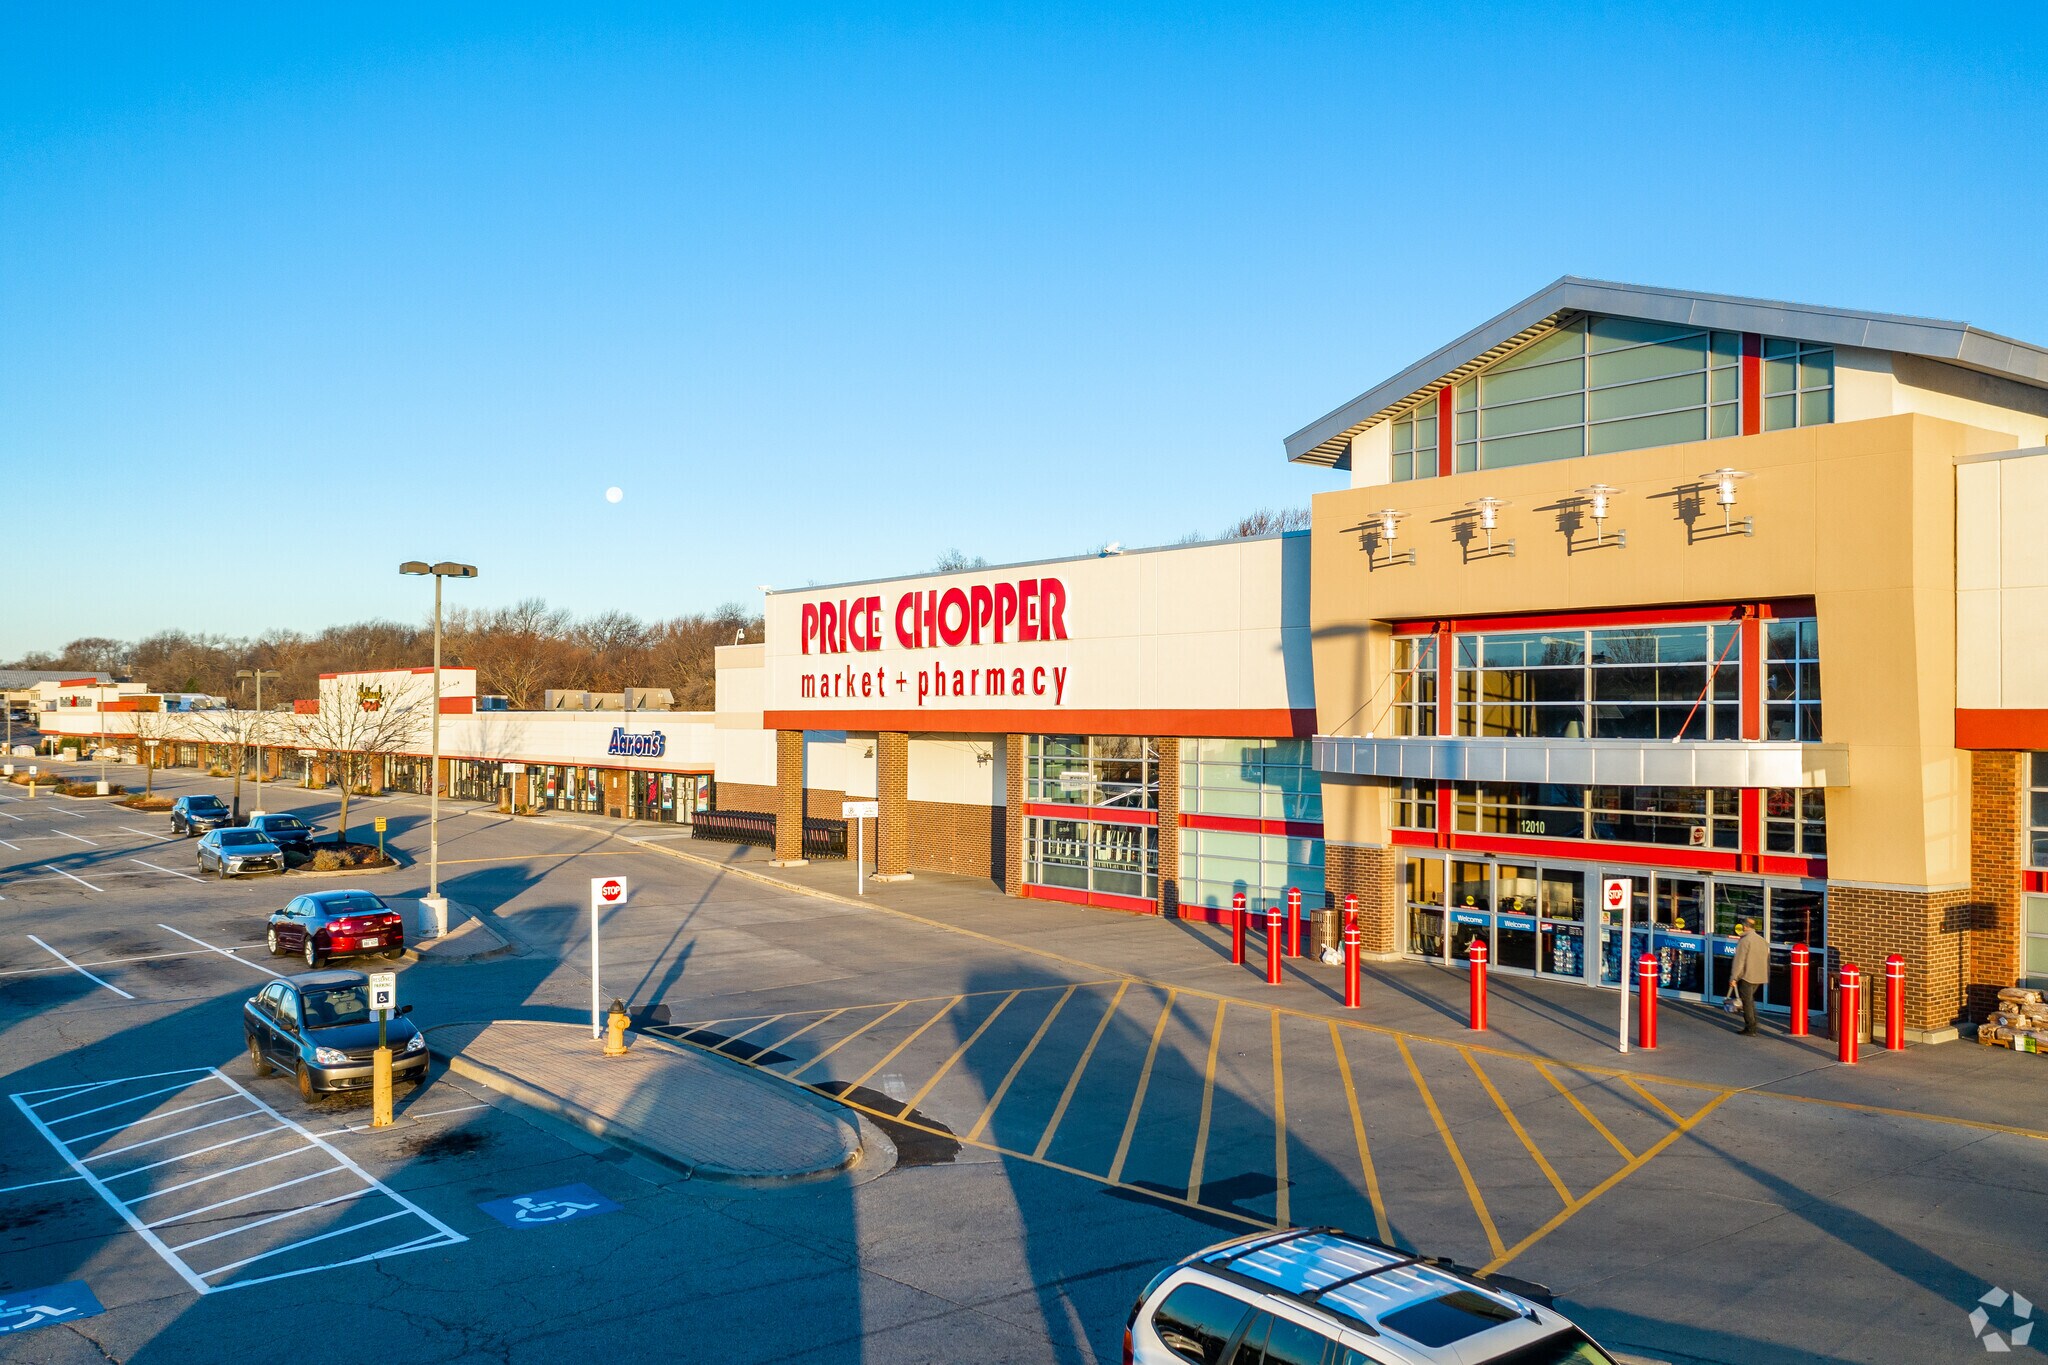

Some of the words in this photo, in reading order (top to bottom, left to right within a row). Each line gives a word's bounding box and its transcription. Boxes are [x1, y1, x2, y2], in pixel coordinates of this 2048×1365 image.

[801, 595, 883, 655] PRICE
[895, 577, 1069, 650] CHOPPER
[801, 664, 886, 698] market
[917, 661, 1068, 706] pharmacy
[607, 726, 665, 758] Aaron's
[1521, 819, 1546, 834] 12010
[602, 885, 621, 896] STOP
[1608, 889, 1623, 900] STOP
[1457, 914, 1483, 924] Welcome
[1504, 919, 1531, 930] Welcome
[1664, 938, 1696, 950] Welcome
